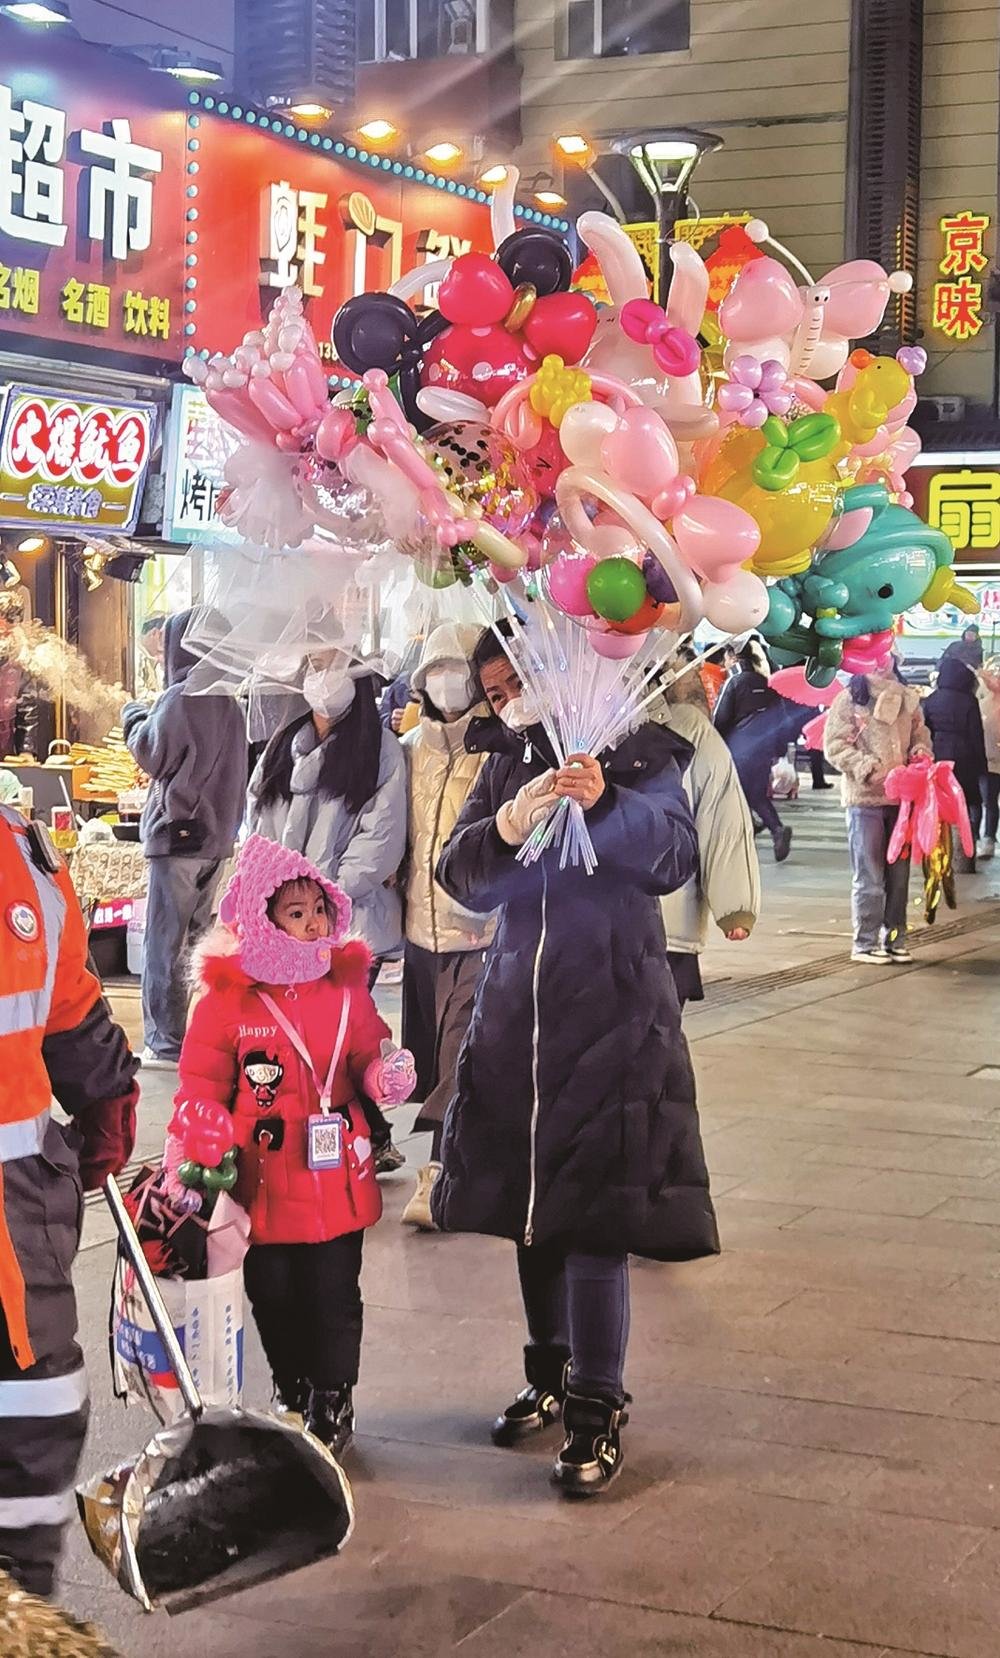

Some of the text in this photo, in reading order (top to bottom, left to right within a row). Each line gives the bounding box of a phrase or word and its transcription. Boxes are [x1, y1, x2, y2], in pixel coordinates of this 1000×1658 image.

[0, 84, 162, 260] 超市
[63, 277, 110, 328] 名酒
[125, 290, 170, 339] 饮料
[933, 211, 990, 338] 京味
[239, 1024, 278, 1038] Happy
